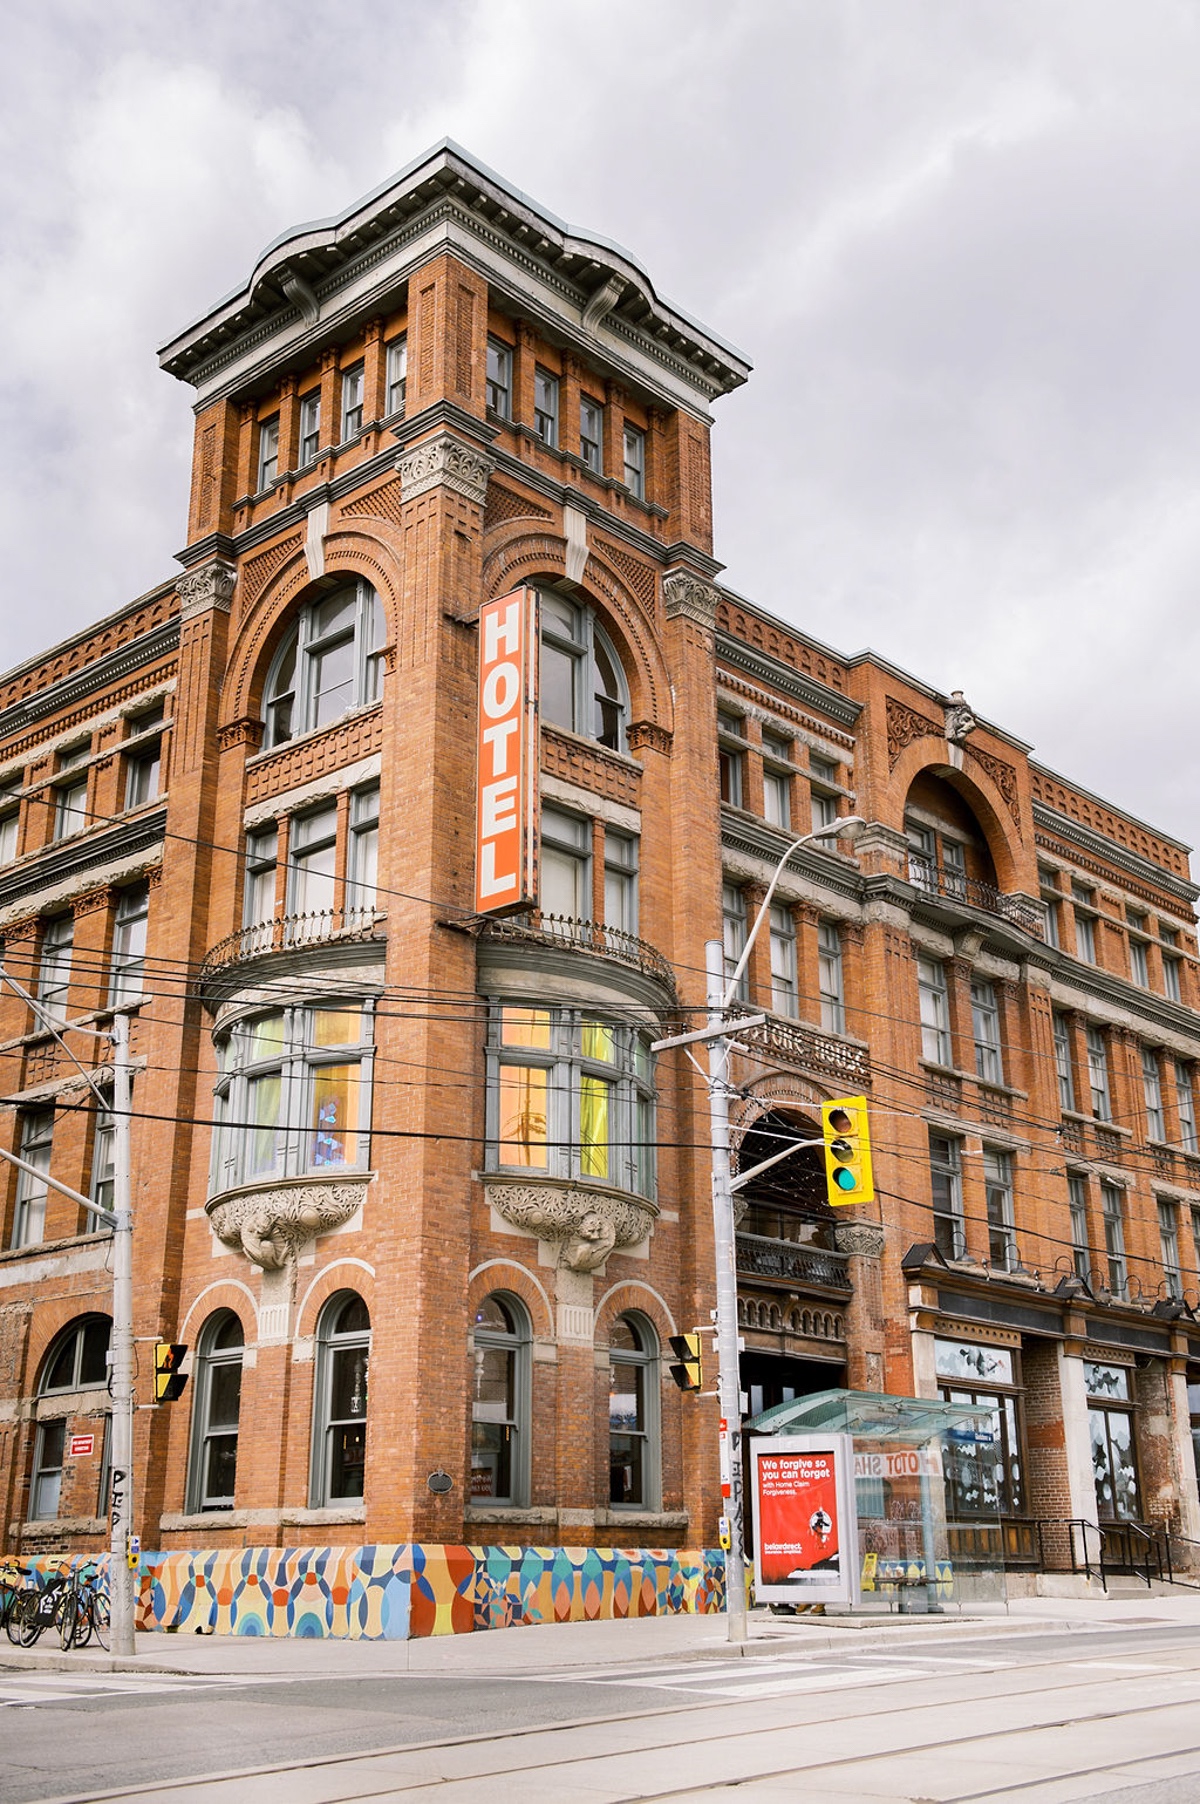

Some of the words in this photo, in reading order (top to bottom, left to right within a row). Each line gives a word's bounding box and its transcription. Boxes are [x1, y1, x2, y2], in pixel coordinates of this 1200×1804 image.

[480, 602, 520, 899] HOTEL
[762, 1460, 778, 1470] We
[779, 1459, 813, 1470] forgive
[815, 1459, 826, 1468] so
[762, 1471, 779, 1481] you
[781, 1470, 798, 1479] can
[801, 1468, 830, 1479] forget
